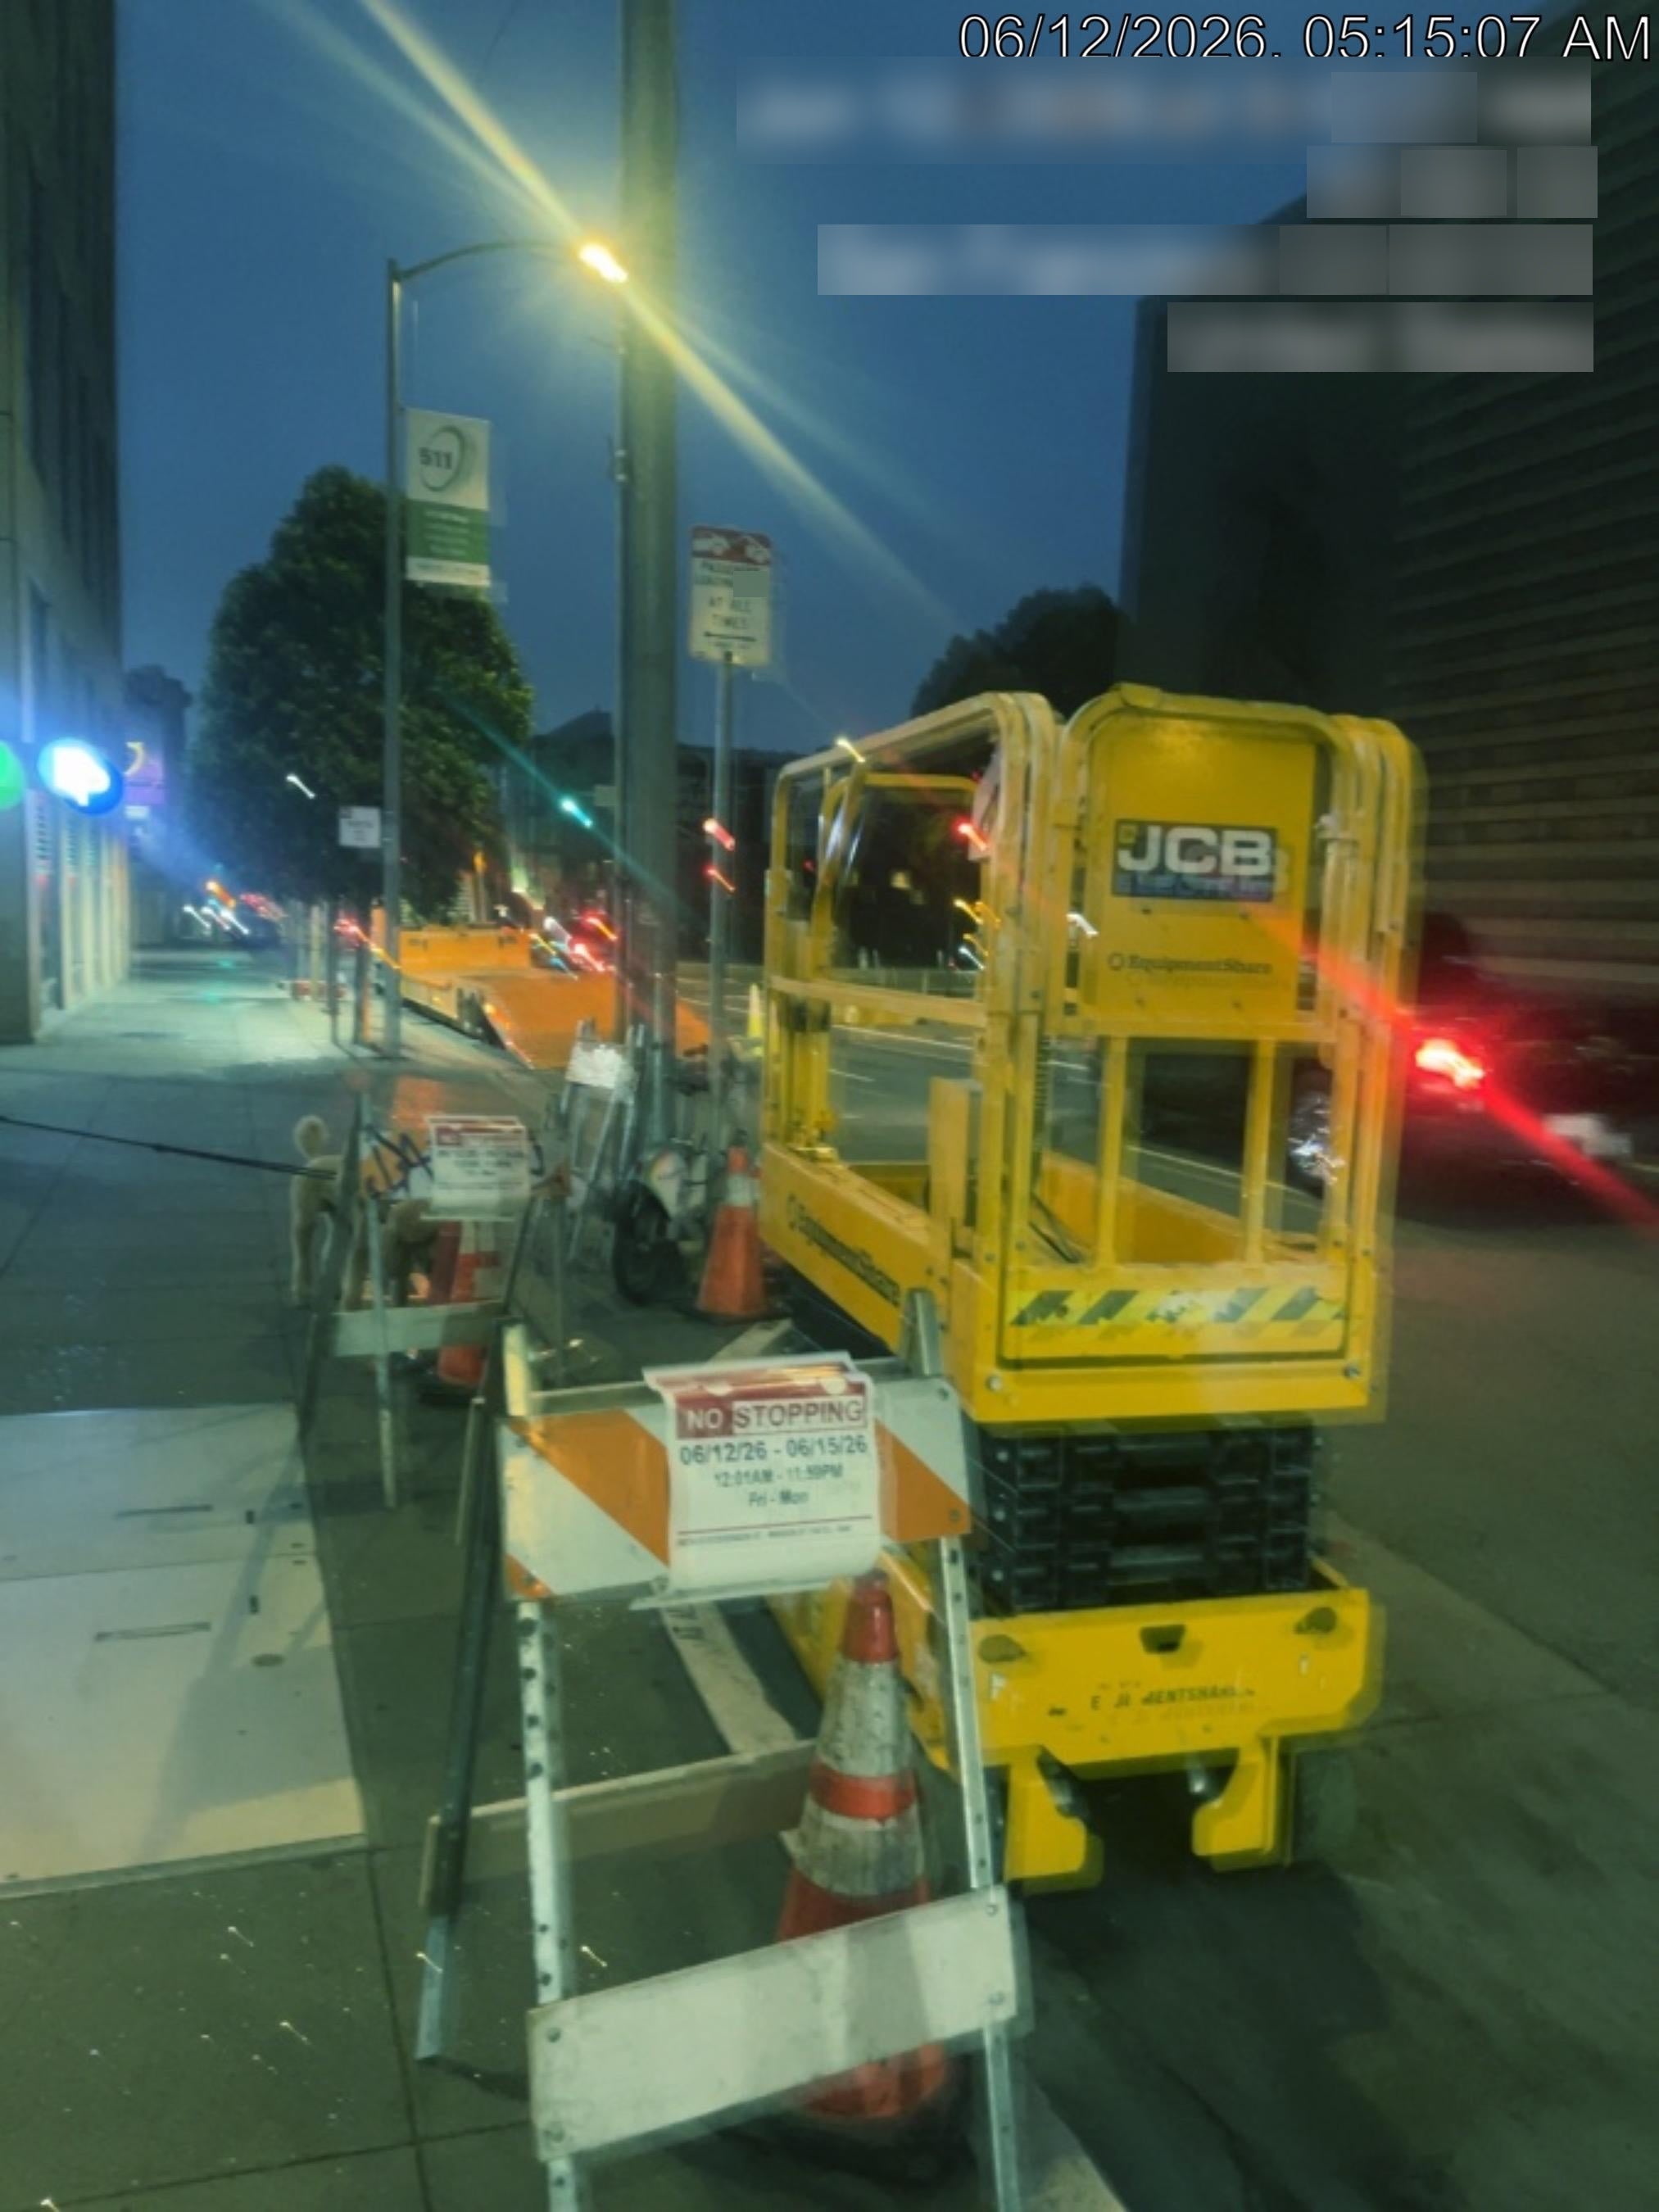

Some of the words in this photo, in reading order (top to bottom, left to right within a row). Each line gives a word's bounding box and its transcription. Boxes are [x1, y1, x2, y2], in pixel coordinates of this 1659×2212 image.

[419, 447, 453, 469] 511
[1117, 825, 1271, 876] JCB
[687, 1407, 723, 1430] NO
[734, 1400, 862, 1429] STOPPING
[680, 1440, 768, 1466] 06/12/26
[786, 1435, 868, 1457] 06/15/26
